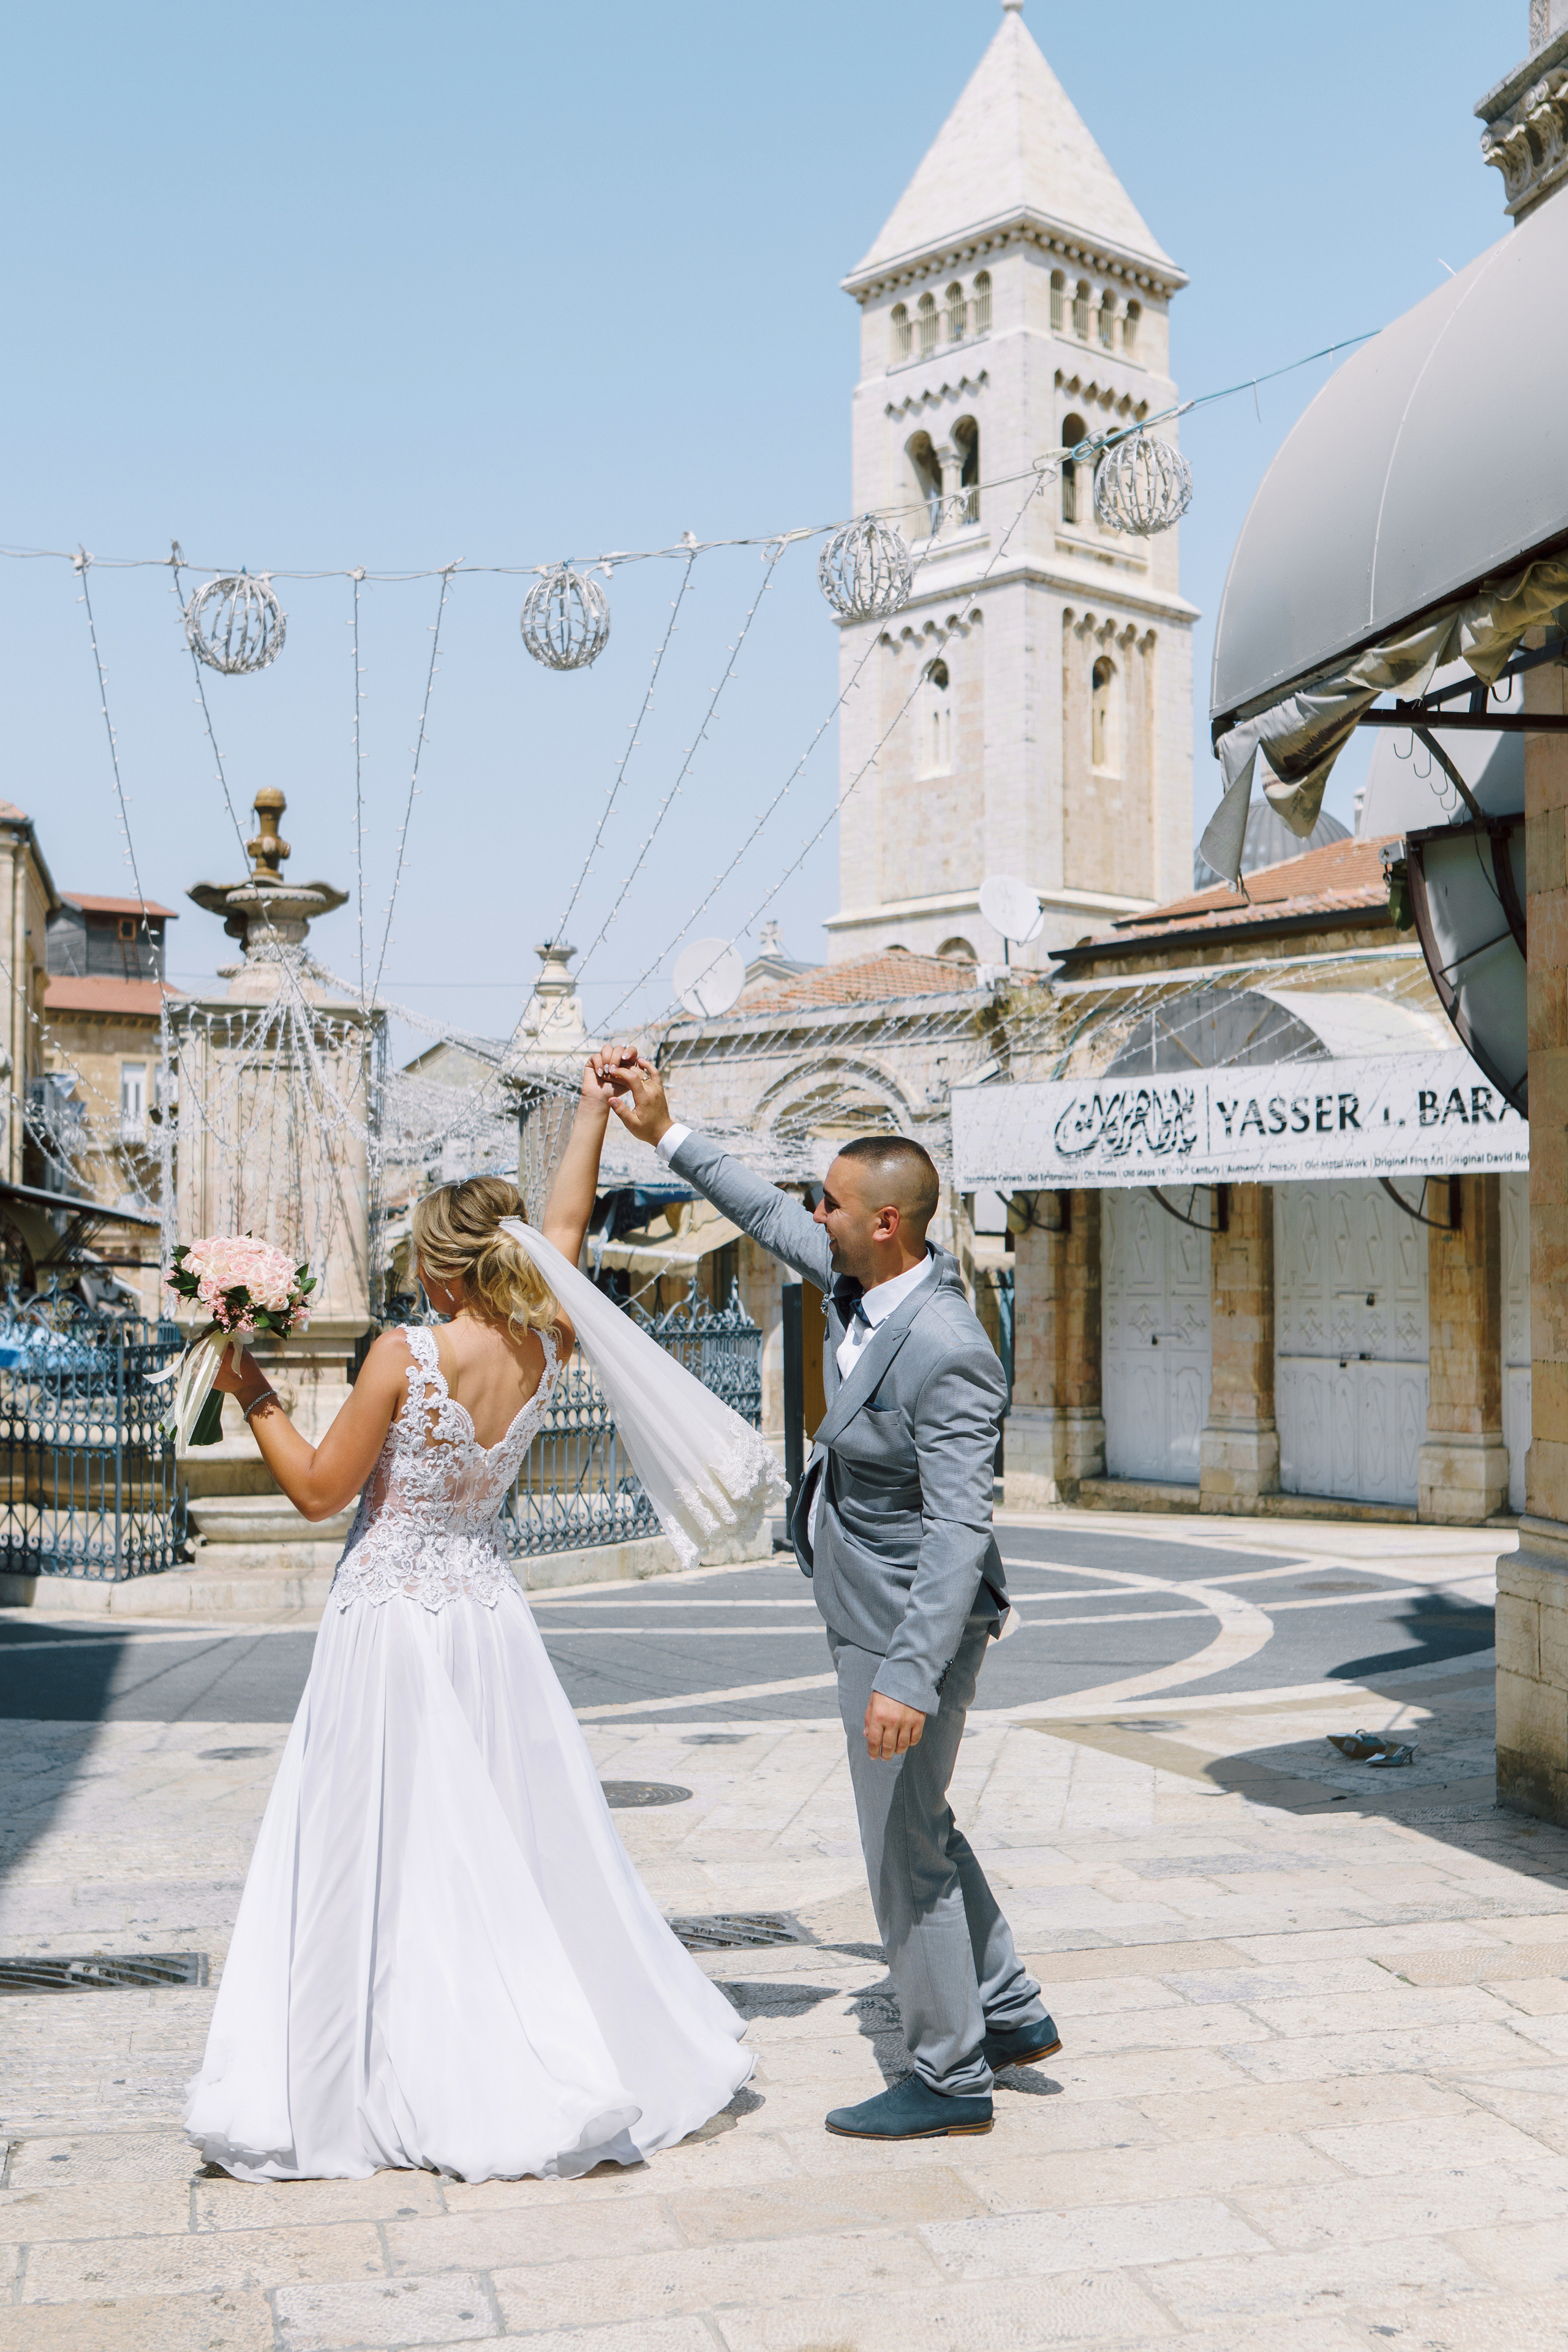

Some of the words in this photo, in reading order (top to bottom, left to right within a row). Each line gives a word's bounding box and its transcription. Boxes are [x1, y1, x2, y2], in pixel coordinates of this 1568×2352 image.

[1216, 1093, 1361, 1137] YASSER
[1028, 1172, 1038, 1182] Old
[1098, 1169, 1117, 1178] Prints
[1123, 1169, 1135, 1178] Old
[1137, 1168, 1155, 1178] Maps
[1191, 1165, 1220, 1175] Century
[1345, 1158, 1368, 1168] Work
[1374, 1155, 1408, 1167] Original
[1410, 1155, 1428, 1166] Fine
[1430, 1154, 1444, 1166] Art
[1486, 1152, 1513, 1163] David
